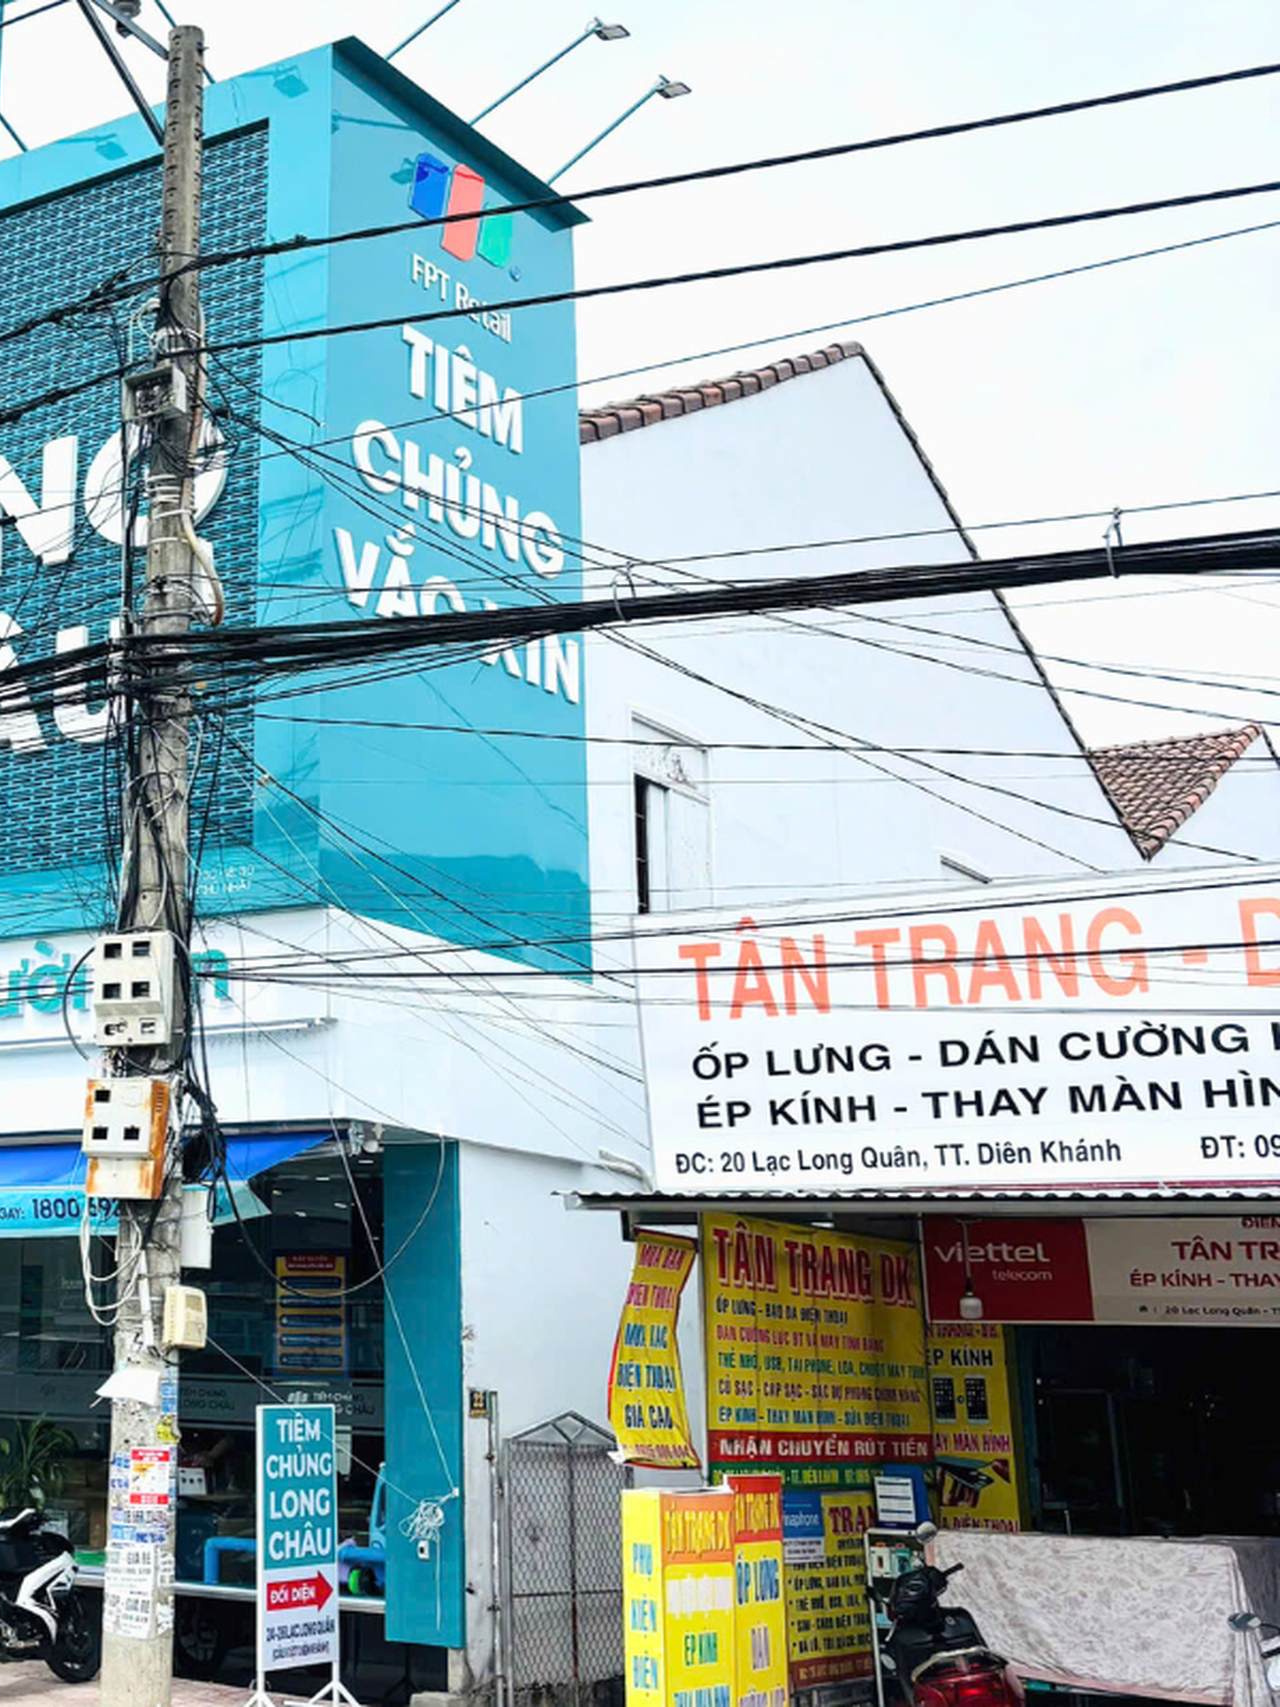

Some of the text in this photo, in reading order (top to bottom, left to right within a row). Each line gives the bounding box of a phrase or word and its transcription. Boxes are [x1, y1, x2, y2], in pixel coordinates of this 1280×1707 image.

[411, 253, 512, 344] FPT Retail
[401, 323, 523, 454] TIÊM
[352, 418, 564, 579] CHỦNG
[677, 917, 831, 1022] TÂN
[854, 906, 1150, 1010] TRANG
[1182, 949, 1208, 964] -
[691, 1041, 750, 1081] ỐP
[767, 1040, 892, 1078] LƯNG
[939, 1032, 1041, 1068] DÁN
[1058, 1018, 1249, 1061] CƯỜNG
[697, 1093, 752, 1130] ÉP
[768, 1090, 877, 1127] KÍNH
[922, 1086, 1050, 1120] THAY
[1070, 1074, 1182, 1113] MÀN
[676, 1152, 714, 1175] ĐC:
[720, 1152, 746, 1174] 20
[752, 1150, 791, 1179] Lạc
[797, 1149, 853, 1179] Long
[860, 1145, 929, 1174] Quân,
[934, 1143, 971, 1169] TT.
[1040, 1136, 1122, 1164] Khánh
[1200, 1135, 1245, 1160] ĐT:
[32, 1197, 80, 1219] 1800
[934, 1241, 1052, 1282] viettel telecom
[1171, 1234, 1232, 1261] TÂN
[712, 1221, 917, 1308] TÂN TRANG DK
[1129, 1268, 1157, 1287] ÉP
[1161, 1268, 1213, 1288] KÍNH
[765, 1303, 783, 1320] BAO
[785, 1305, 797, 1321] DA
[1202, 1305, 1229, 1317] Long
[1232, 1305, 1261, 1317] Quân
[950, 1344, 994, 1368] KÍNH
[277, 1411, 321, 1444] TIÊM
[624, 1399, 673, 1430] GIÁ CAO
[718, 1405, 732, 1423] ÉP
[719, 1435, 772, 1459] NHẬN
[777, 1433, 850, 1457] CHUYỂN
[854, 1438, 888, 1457] RÚT
[952, 1428, 1012, 1453] MÀN HÌNH
[266, 1444, 332, 1479] CHỦNG
[269, 1487, 331, 1519] LONG
[784, 1511, 820, 1528] naphone
[268, 1521, 332, 1560] CHÂU
[270, 1583, 316, 1604] ĐỐI DIỆN
